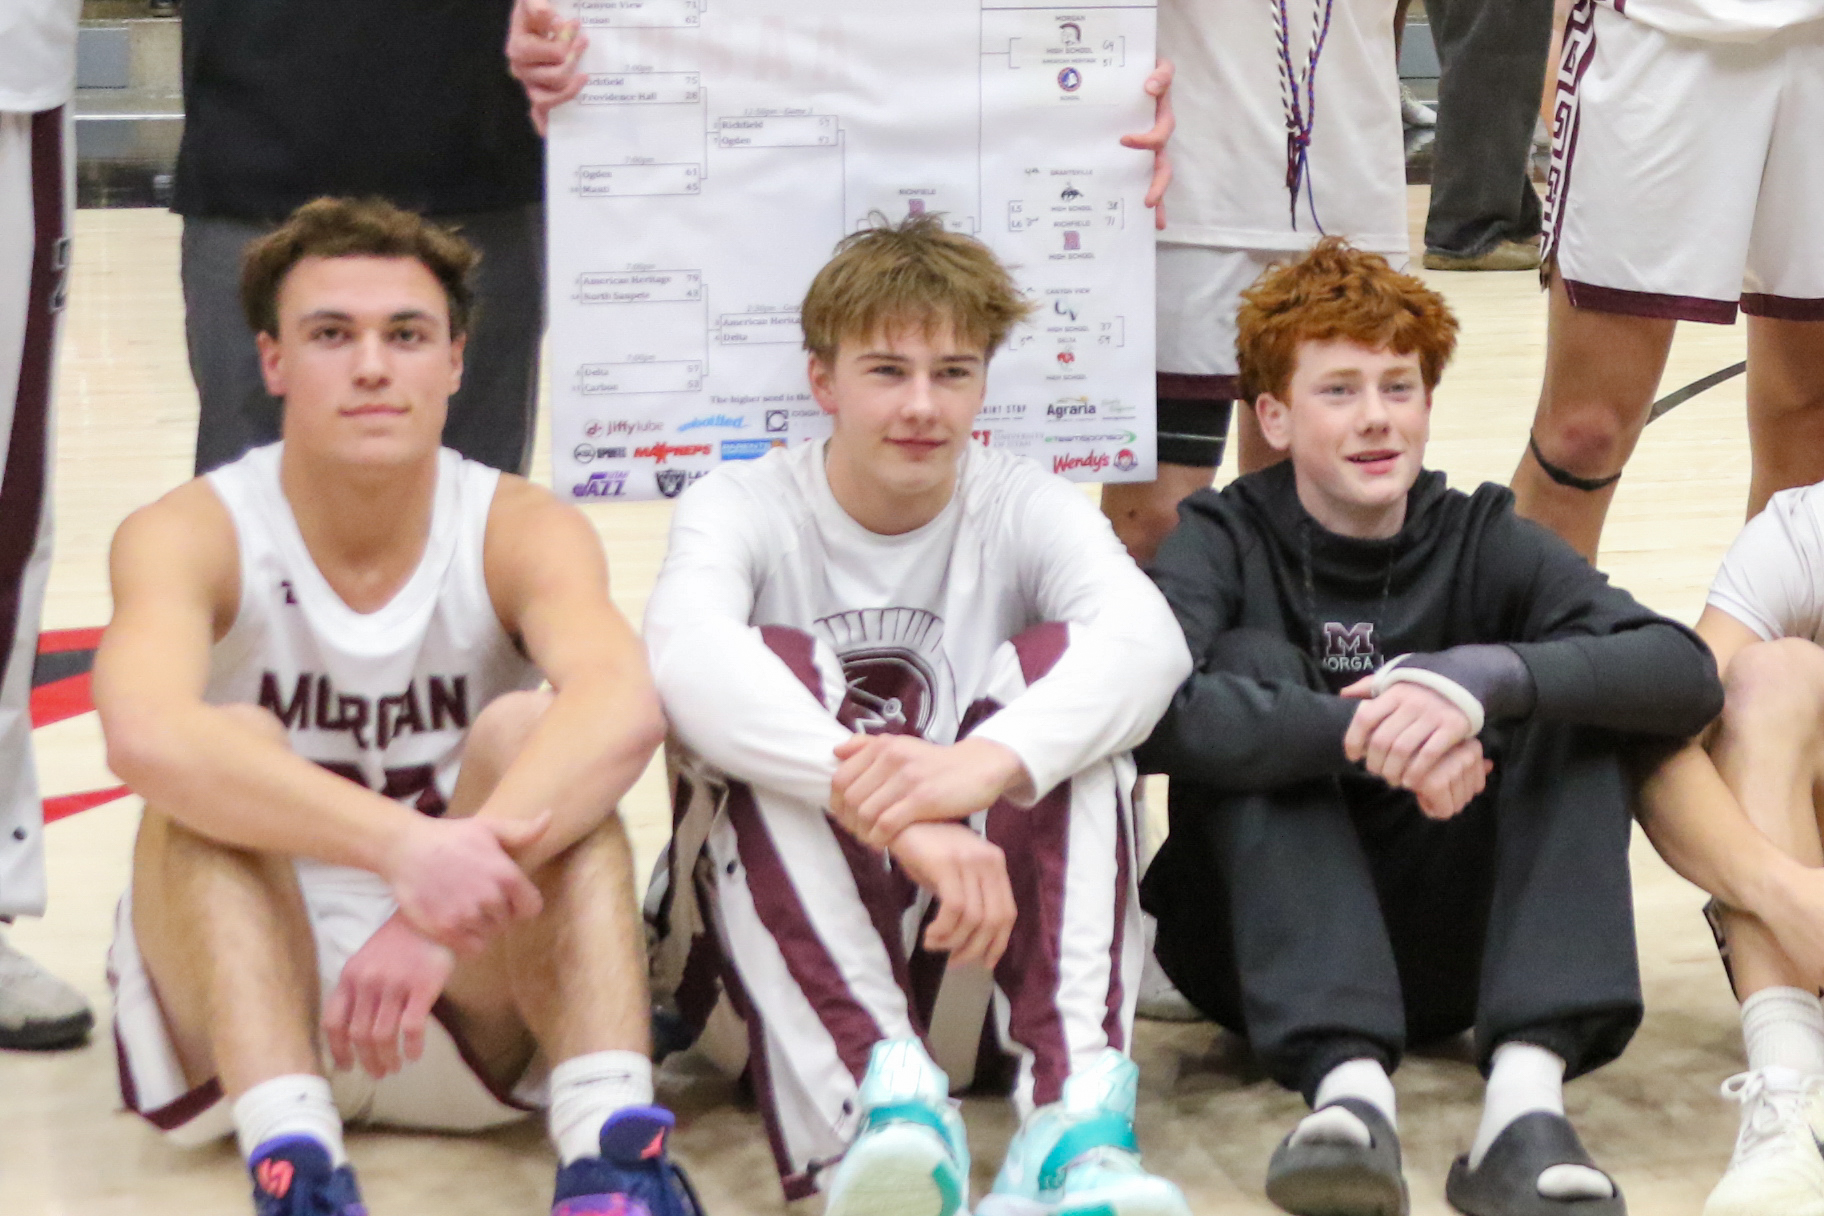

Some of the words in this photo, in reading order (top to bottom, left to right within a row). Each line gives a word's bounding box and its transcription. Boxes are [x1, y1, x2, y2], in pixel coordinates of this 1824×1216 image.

[1047, 402, 1096, 419] Agraria
[1053, 450, 1110, 474] Wendy's
[1324, 622, 1374, 656] M
[1322, 655, 1384, 672] ORGA
